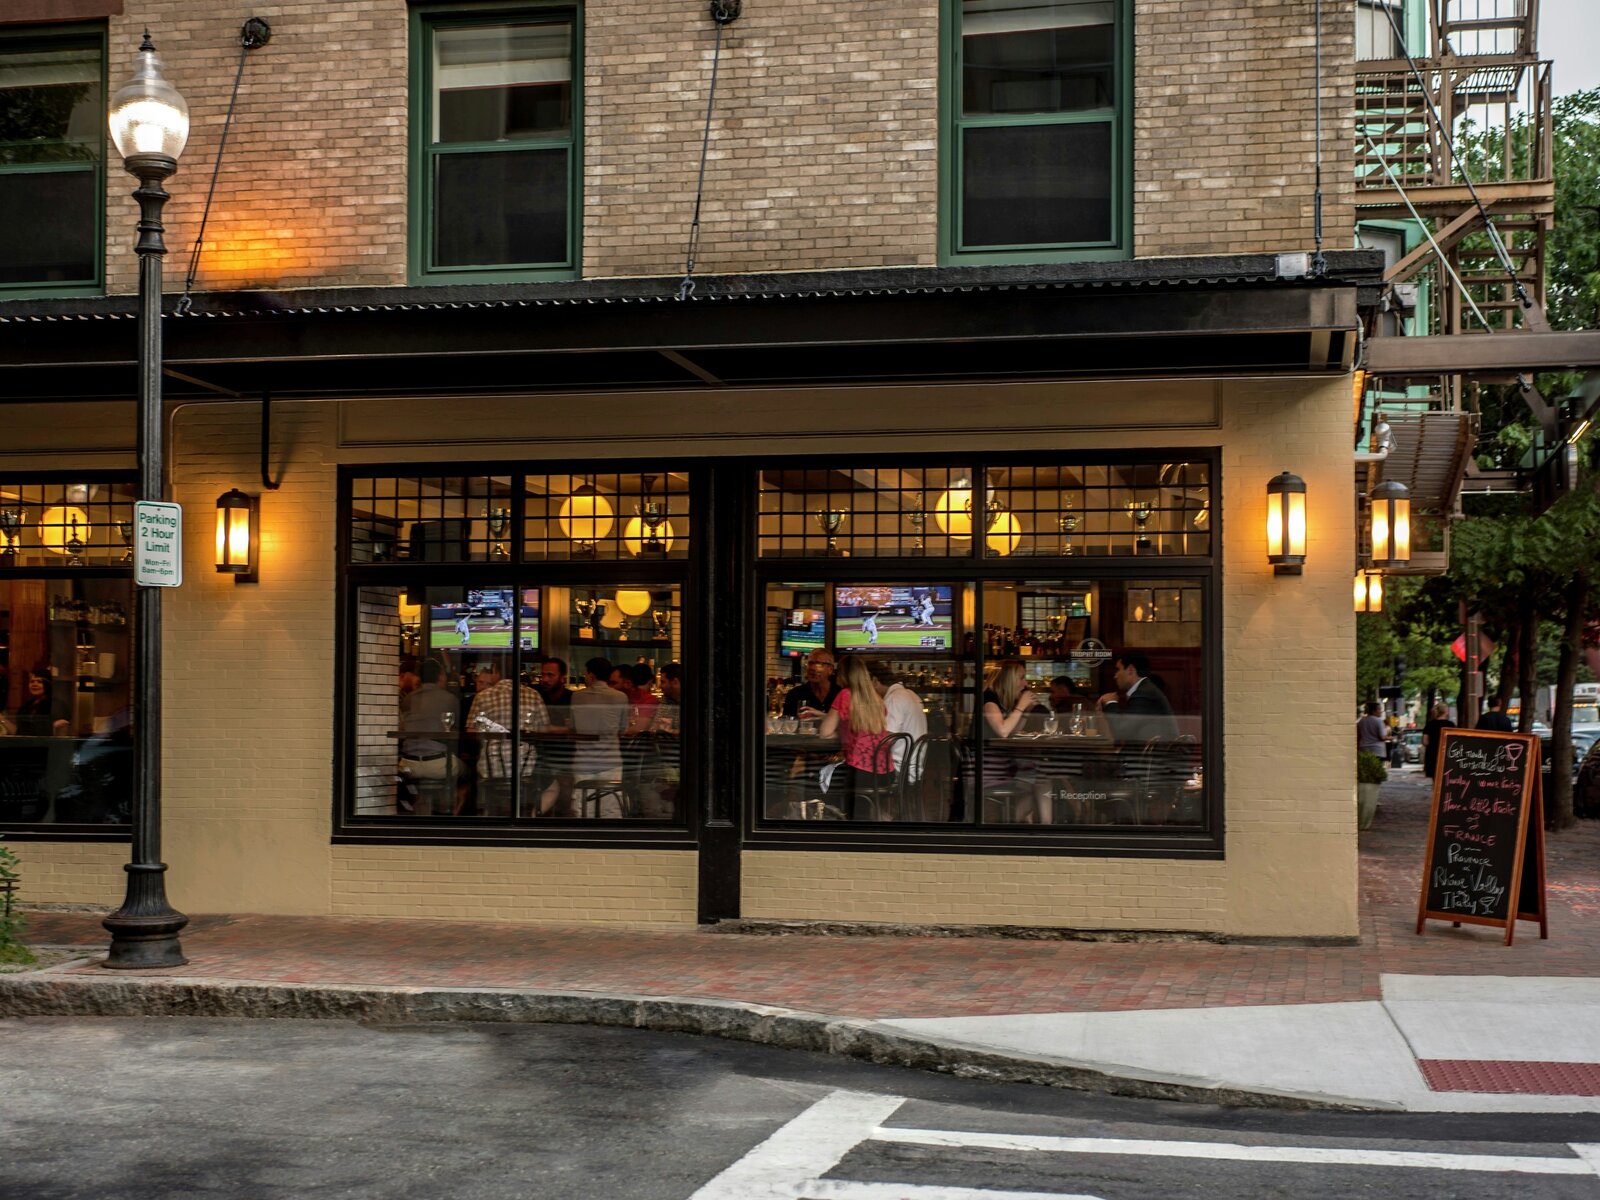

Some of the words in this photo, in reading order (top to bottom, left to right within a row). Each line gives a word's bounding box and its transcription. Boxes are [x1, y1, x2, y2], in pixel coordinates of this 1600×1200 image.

[139, 512, 177, 528] Parking
[141, 527, 149, 537] 2
[151, 528, 175, 539] Hour
[145, 541, 171, 553] Limit
[1448, 741, 1464, 759] Get
[1060, 790, 1106, 802] Reception
[1443, 825, 1496, 846] FRANCE
[1441, 891, 1477, 914] Italy
